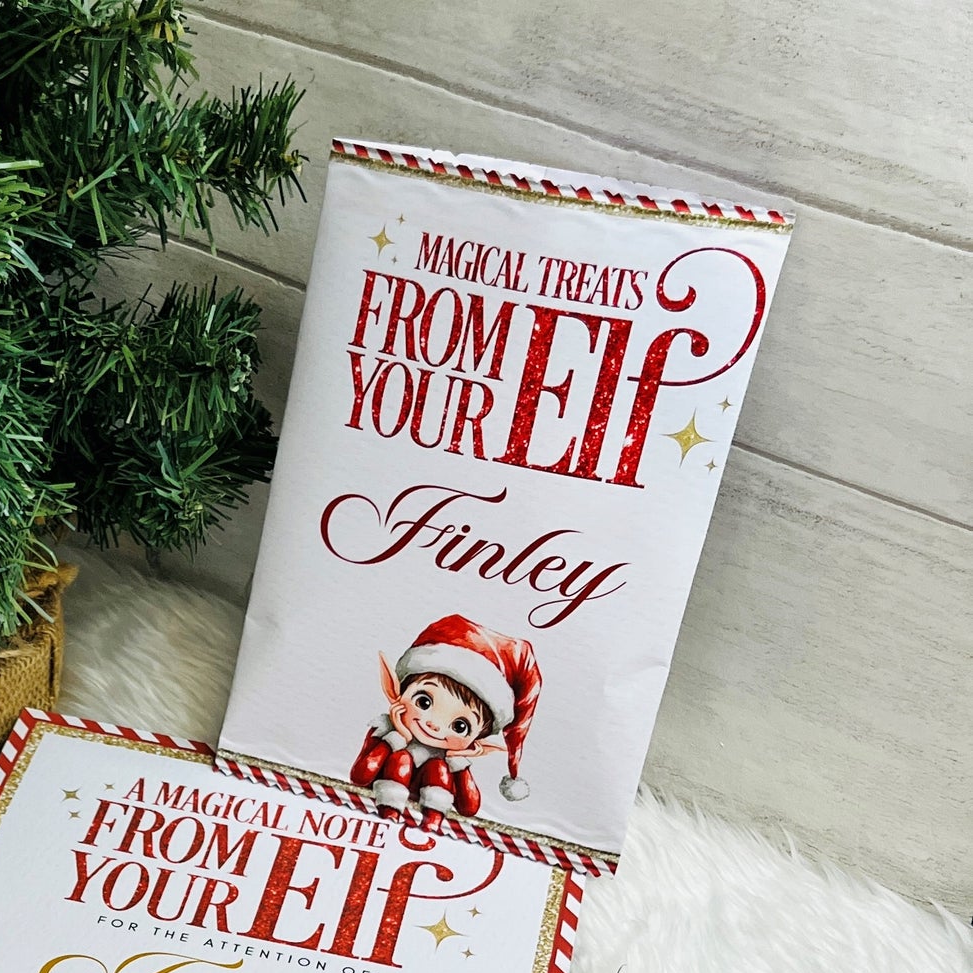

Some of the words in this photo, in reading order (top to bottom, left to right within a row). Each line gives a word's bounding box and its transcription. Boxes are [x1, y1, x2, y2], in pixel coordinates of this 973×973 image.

[415, 232, 529, 293] MAGICAL
[537, 256, 648, 310] TREATS
[347, 270, 518, 381] FROM
[493, 247, 766, 489] Elf
[345, 350, 495, 460] YOUR
[320, 485, 632, 629] Finley
[79, 798, 263, 877] FROM
[123, 777, 146, 801] A
[154, 781, 288, 831] MAGICAL
[299, 809, 391, 849] NOTE
[64, 849, 239, 935] YOUR
[236, 823, 505, 969] Elf
[96, 914, 139, 933] FOR
[152, 926, 188, 943] THE
[202, 937, 328, 971] ATTENTION
